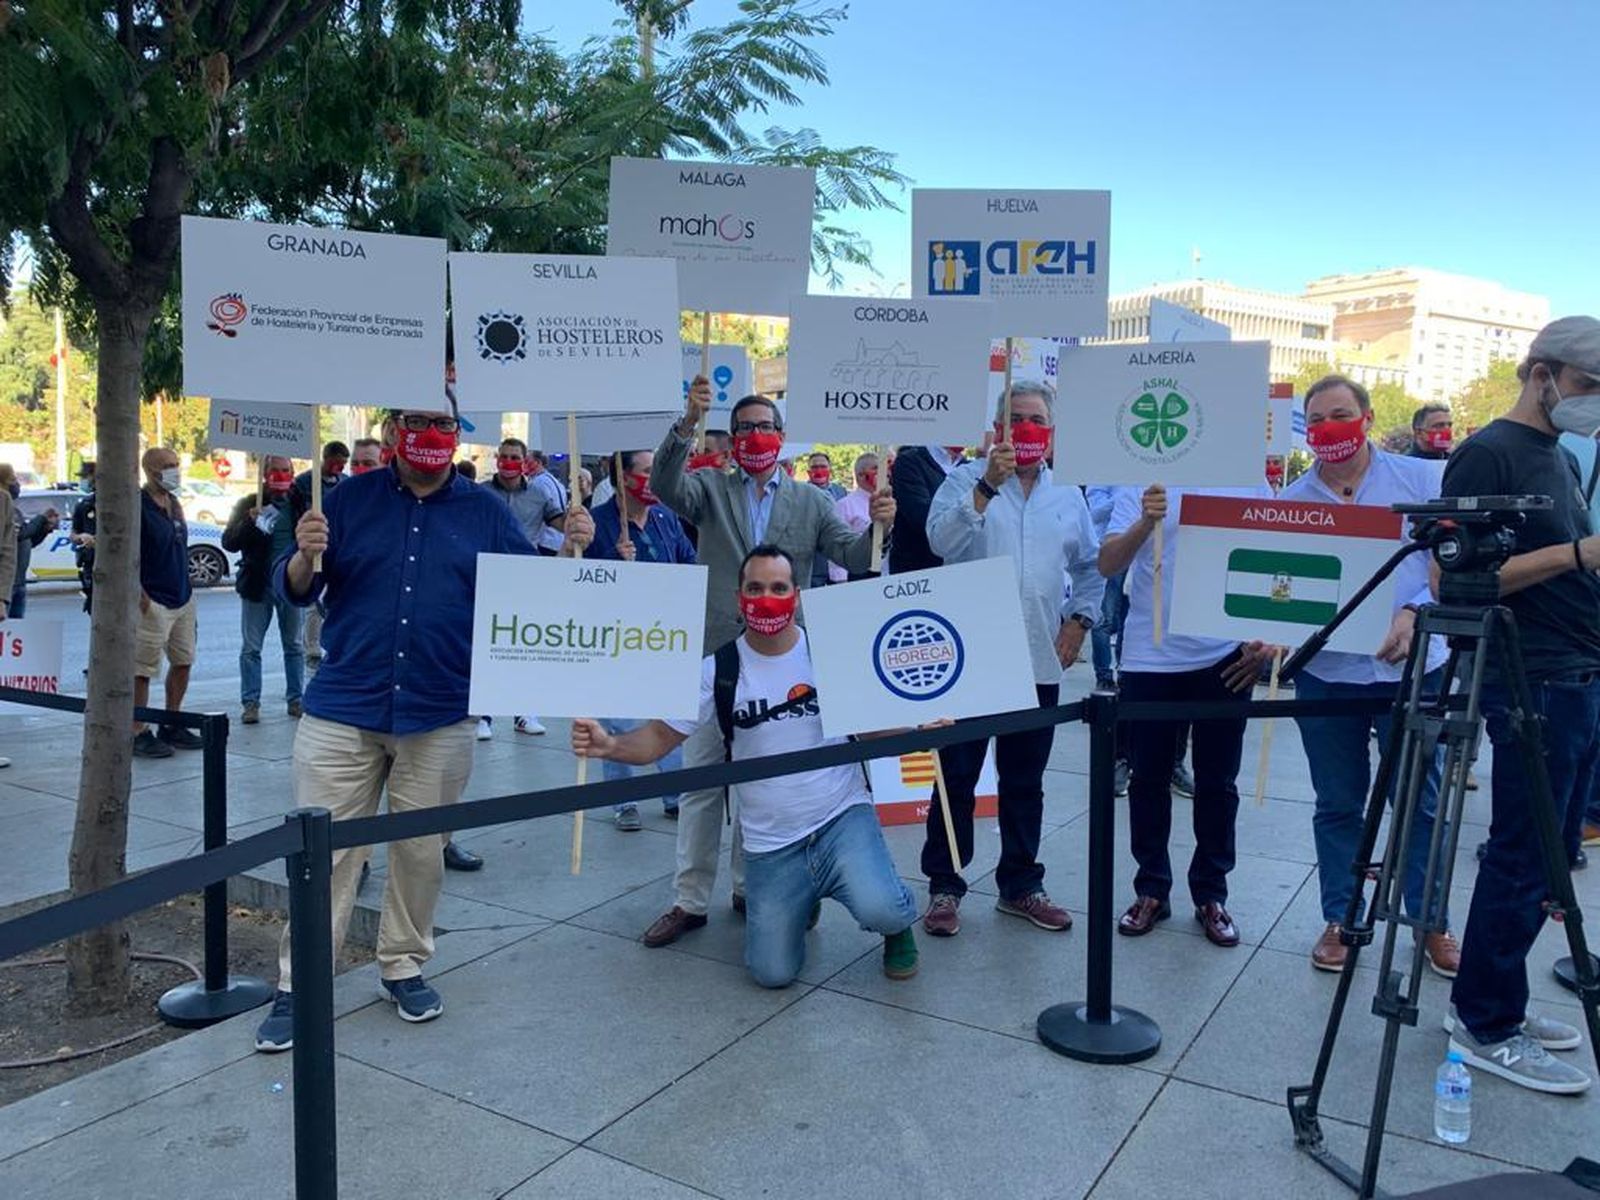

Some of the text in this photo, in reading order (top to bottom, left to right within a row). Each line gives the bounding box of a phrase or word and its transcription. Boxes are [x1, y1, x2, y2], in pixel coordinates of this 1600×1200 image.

[987, 199, 1039, 213] HUELVA
[267, 233, 367, 260] GRANADA
[533, 263, 598, 280] SEVILLA
[359, 314, 373, 324] de
[375, 314, 424, 328] Empresas
[536, 314, 622, 326] ASOCIACIÓN
[854, 303, 929, 324] CÓRDOBA
[251, 318, 265, 327] de
[326, 321, 365, 335] Turismo
[366, 326, 380, 336] de
[381, 326, 424, 339] Granada
[537, 328, 664, 345] HOSTELEROS
[555, 346, 641, 358] SEVILLA
[1128, 349, 1196, 367] ALMERÍA
[1143, 377, 1178, 391] ASHAL
[824, 391, 950, 412] HOSTECOR
[241, 427, 256, 437] DE
[1242, 507, 1336, 527] ANDALUCÍA
[574, 565, 617, 584] JAÉN
[491, 613, 688, 658] Hosturjaén
[887, 645, 951, 666] HORECA
